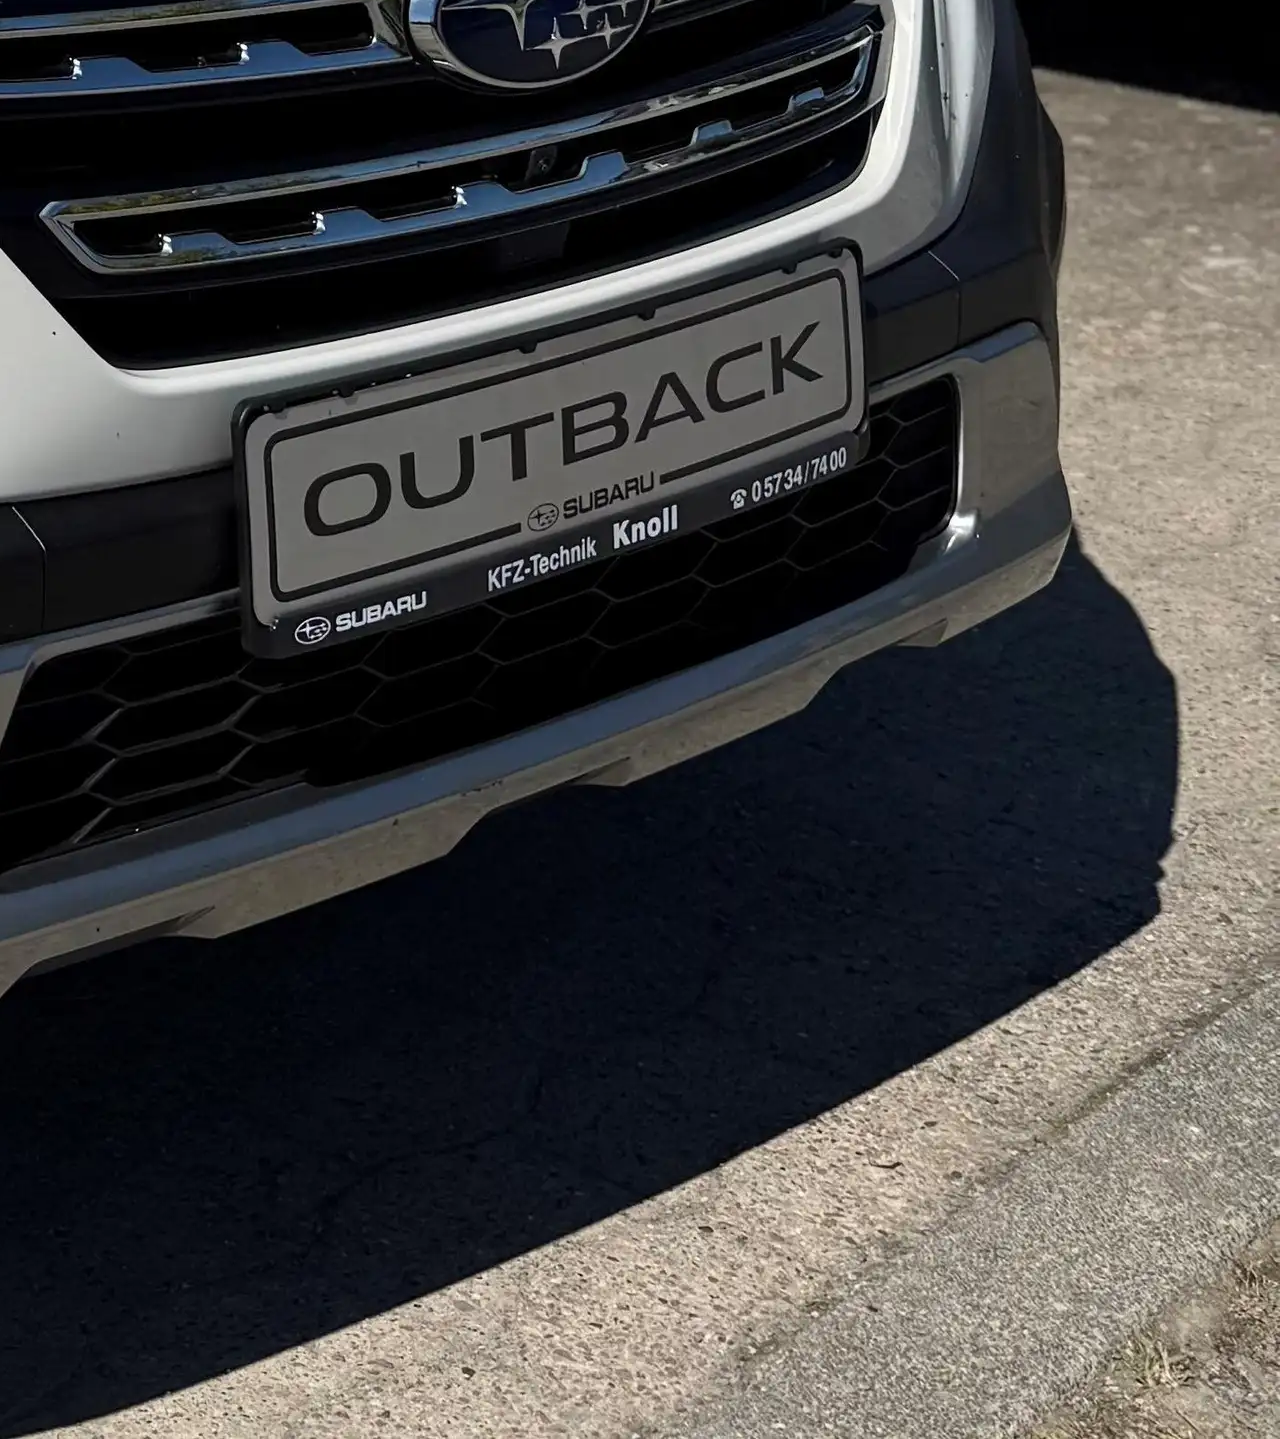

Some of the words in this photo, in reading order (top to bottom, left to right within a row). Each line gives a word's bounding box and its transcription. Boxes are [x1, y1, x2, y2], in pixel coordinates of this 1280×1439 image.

[304, 320, 824, 537] OUTBACK
[562, 470, 655, 520] SUBARU
[335, 590, 427, 632] SUBARU
[487, 536, 598, 592] KFZ-Technik
[612, 503, 679, 550] Knoll
